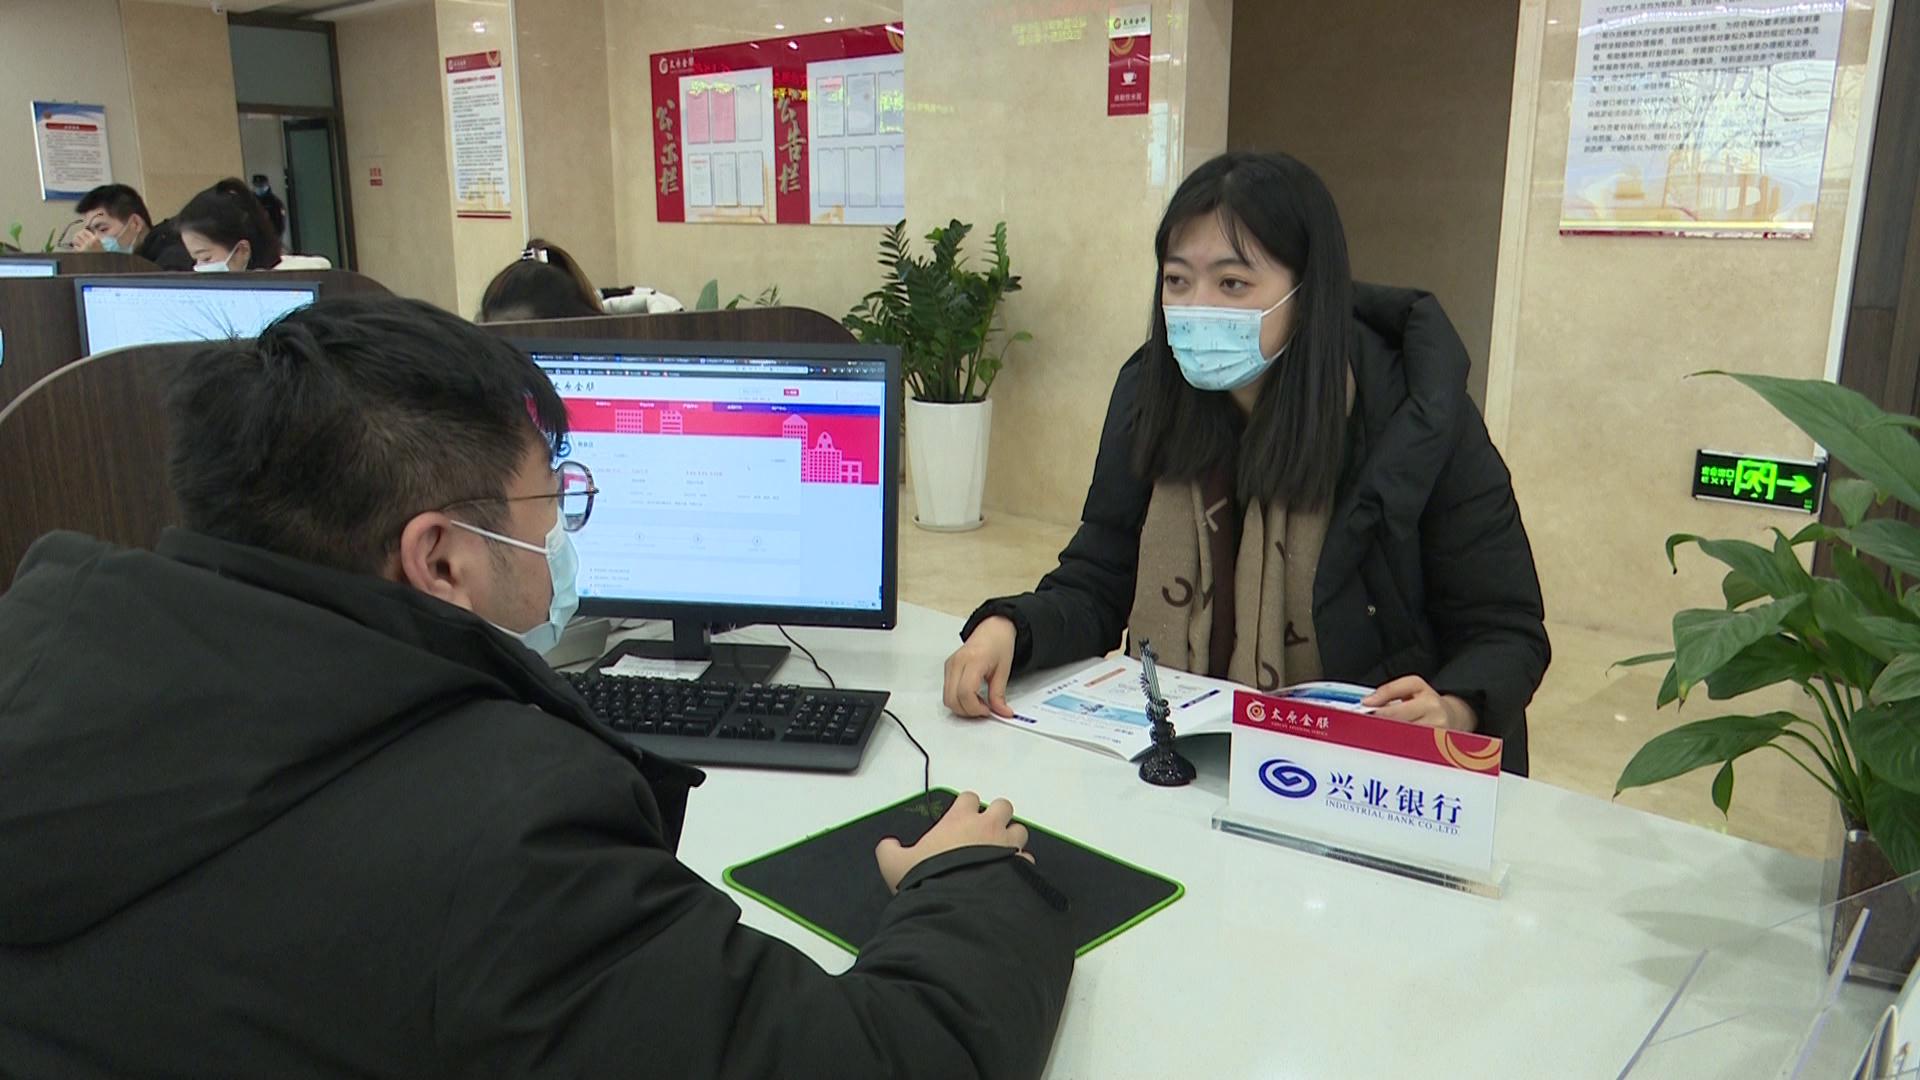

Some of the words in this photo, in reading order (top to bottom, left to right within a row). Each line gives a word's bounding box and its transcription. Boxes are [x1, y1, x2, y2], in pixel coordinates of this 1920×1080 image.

[656, 99, 679, 195] 公示栏
[776, 89, 807, 195] 公告栏
[1700, 476, 1734, 487] EXIT
[1271, 707, 1329, 729] 太原金服
[1325, 799, 1384, 820] INDUSTRIAL
[1387, 814, 1415, 826] BANK
[1328, 771, 1462, 824] 兴业银行
